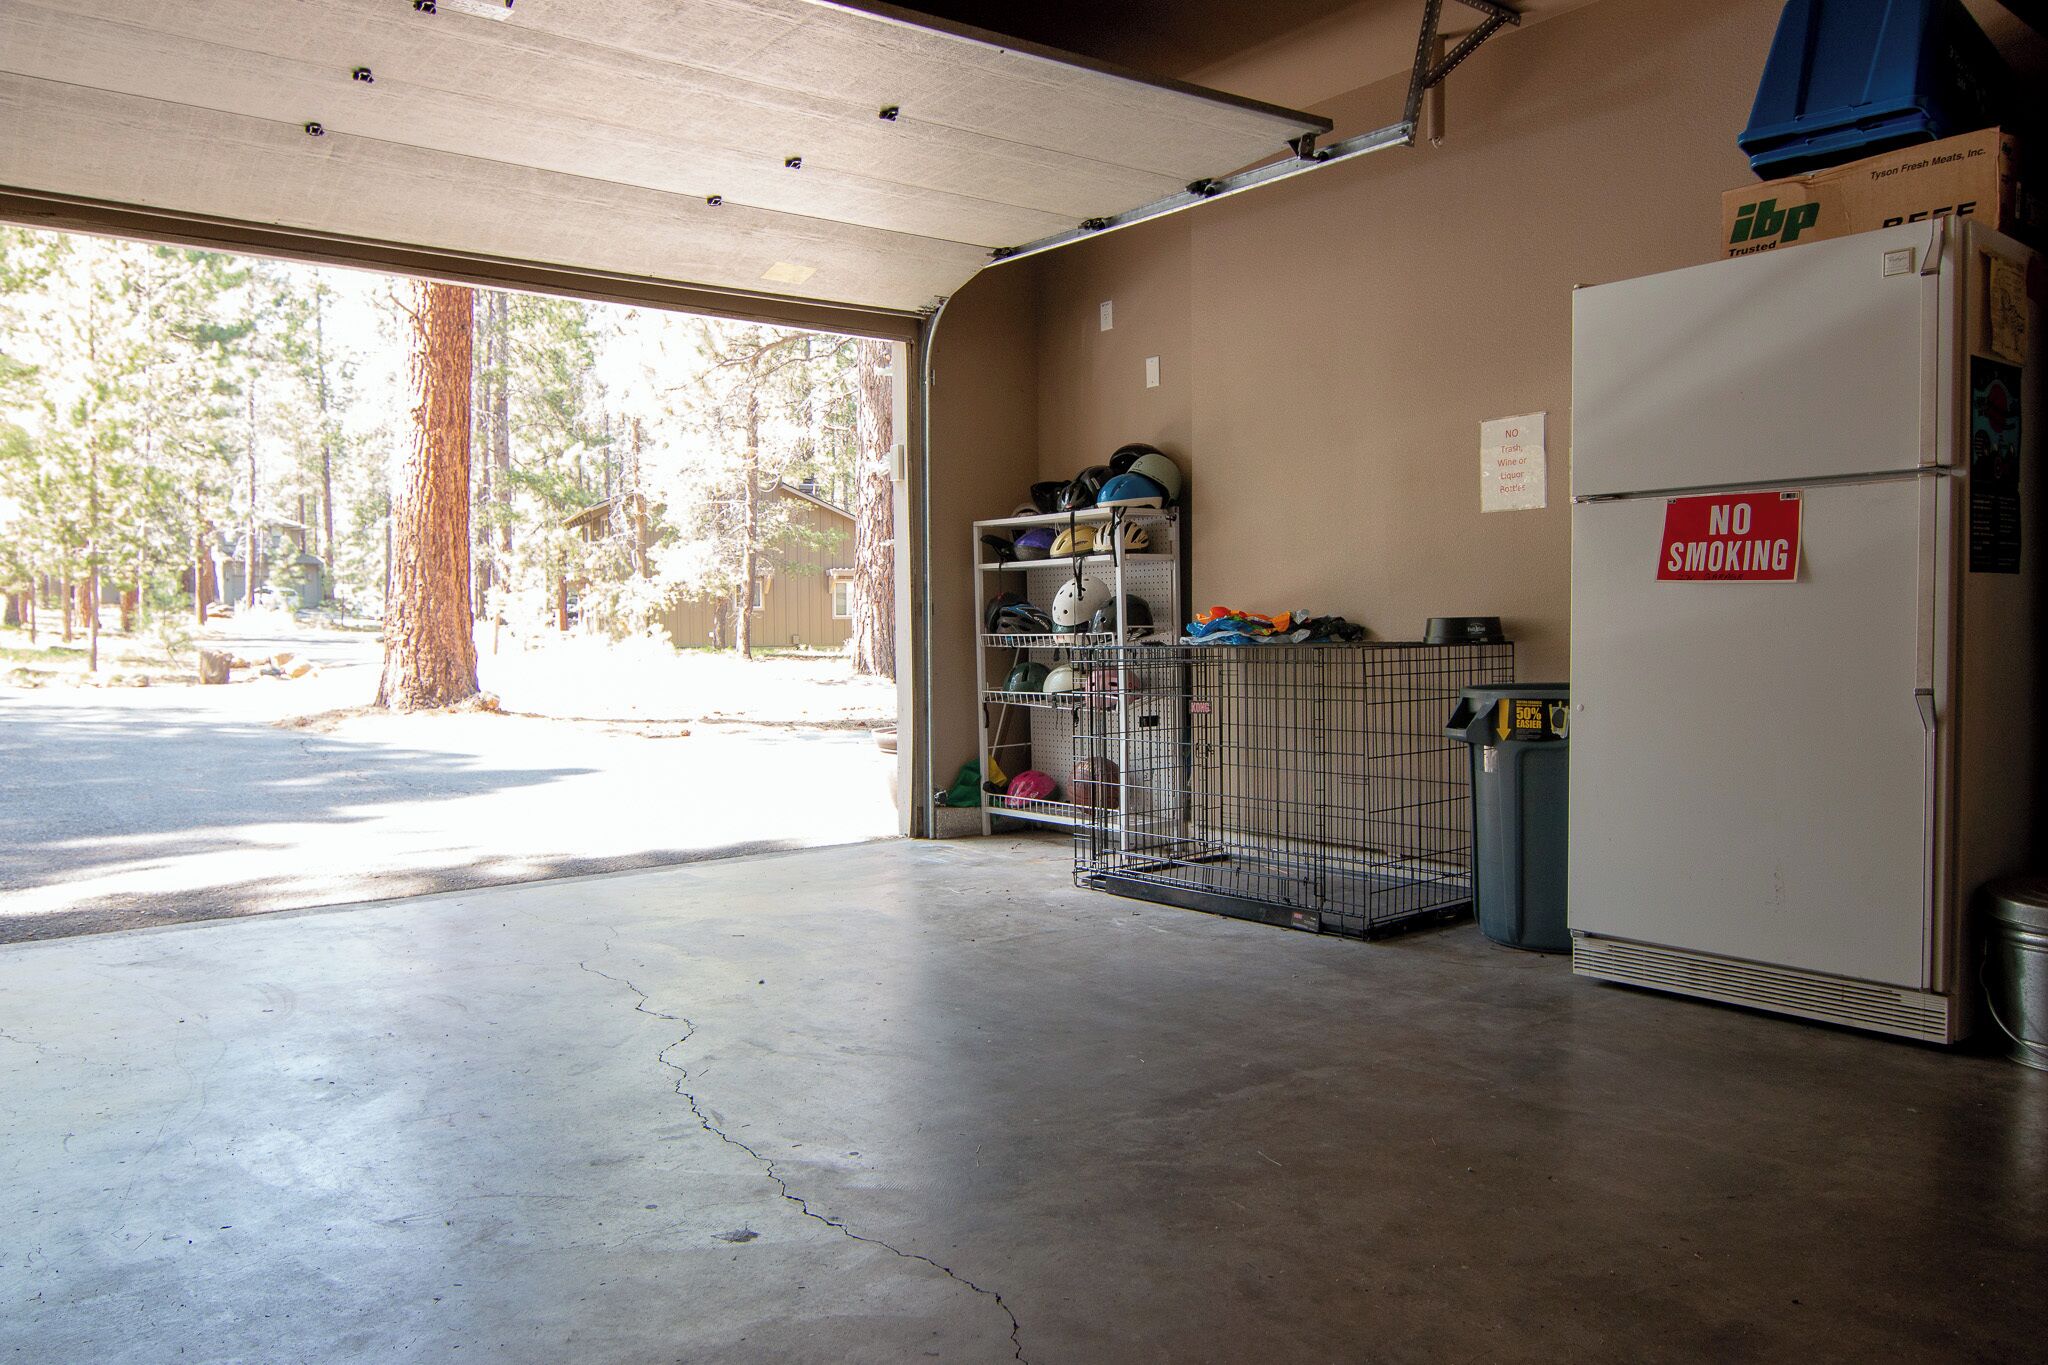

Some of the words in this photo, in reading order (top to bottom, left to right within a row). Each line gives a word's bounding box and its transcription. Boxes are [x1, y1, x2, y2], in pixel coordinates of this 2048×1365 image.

[1870, 166, 1898, 180] Tyson
[1901, 160, 1929, 173] Fresh
[1932, 152, 1965, 166] Meats,
[1967, 148, 1986, 158] Inc.
[1729, 198, 1820, 244] ibp
[1728, 240, 1777, 257] Trusted
[1505, 428, 1519, 438] NO
[1501, 444, 1523, 453] Trash,
[1497, 459, 1517, 467] Wine
[1500, 471, 1525, 481] Liquor
[1708, 503, 1751, 535] NO
[1667, 538, 1789, 572] SMOKING
[1190, 702, 1211, 713] KONG
[1516, 706, 1542, 720] 50%
[1516, 719, 1542, 729] EASIER
